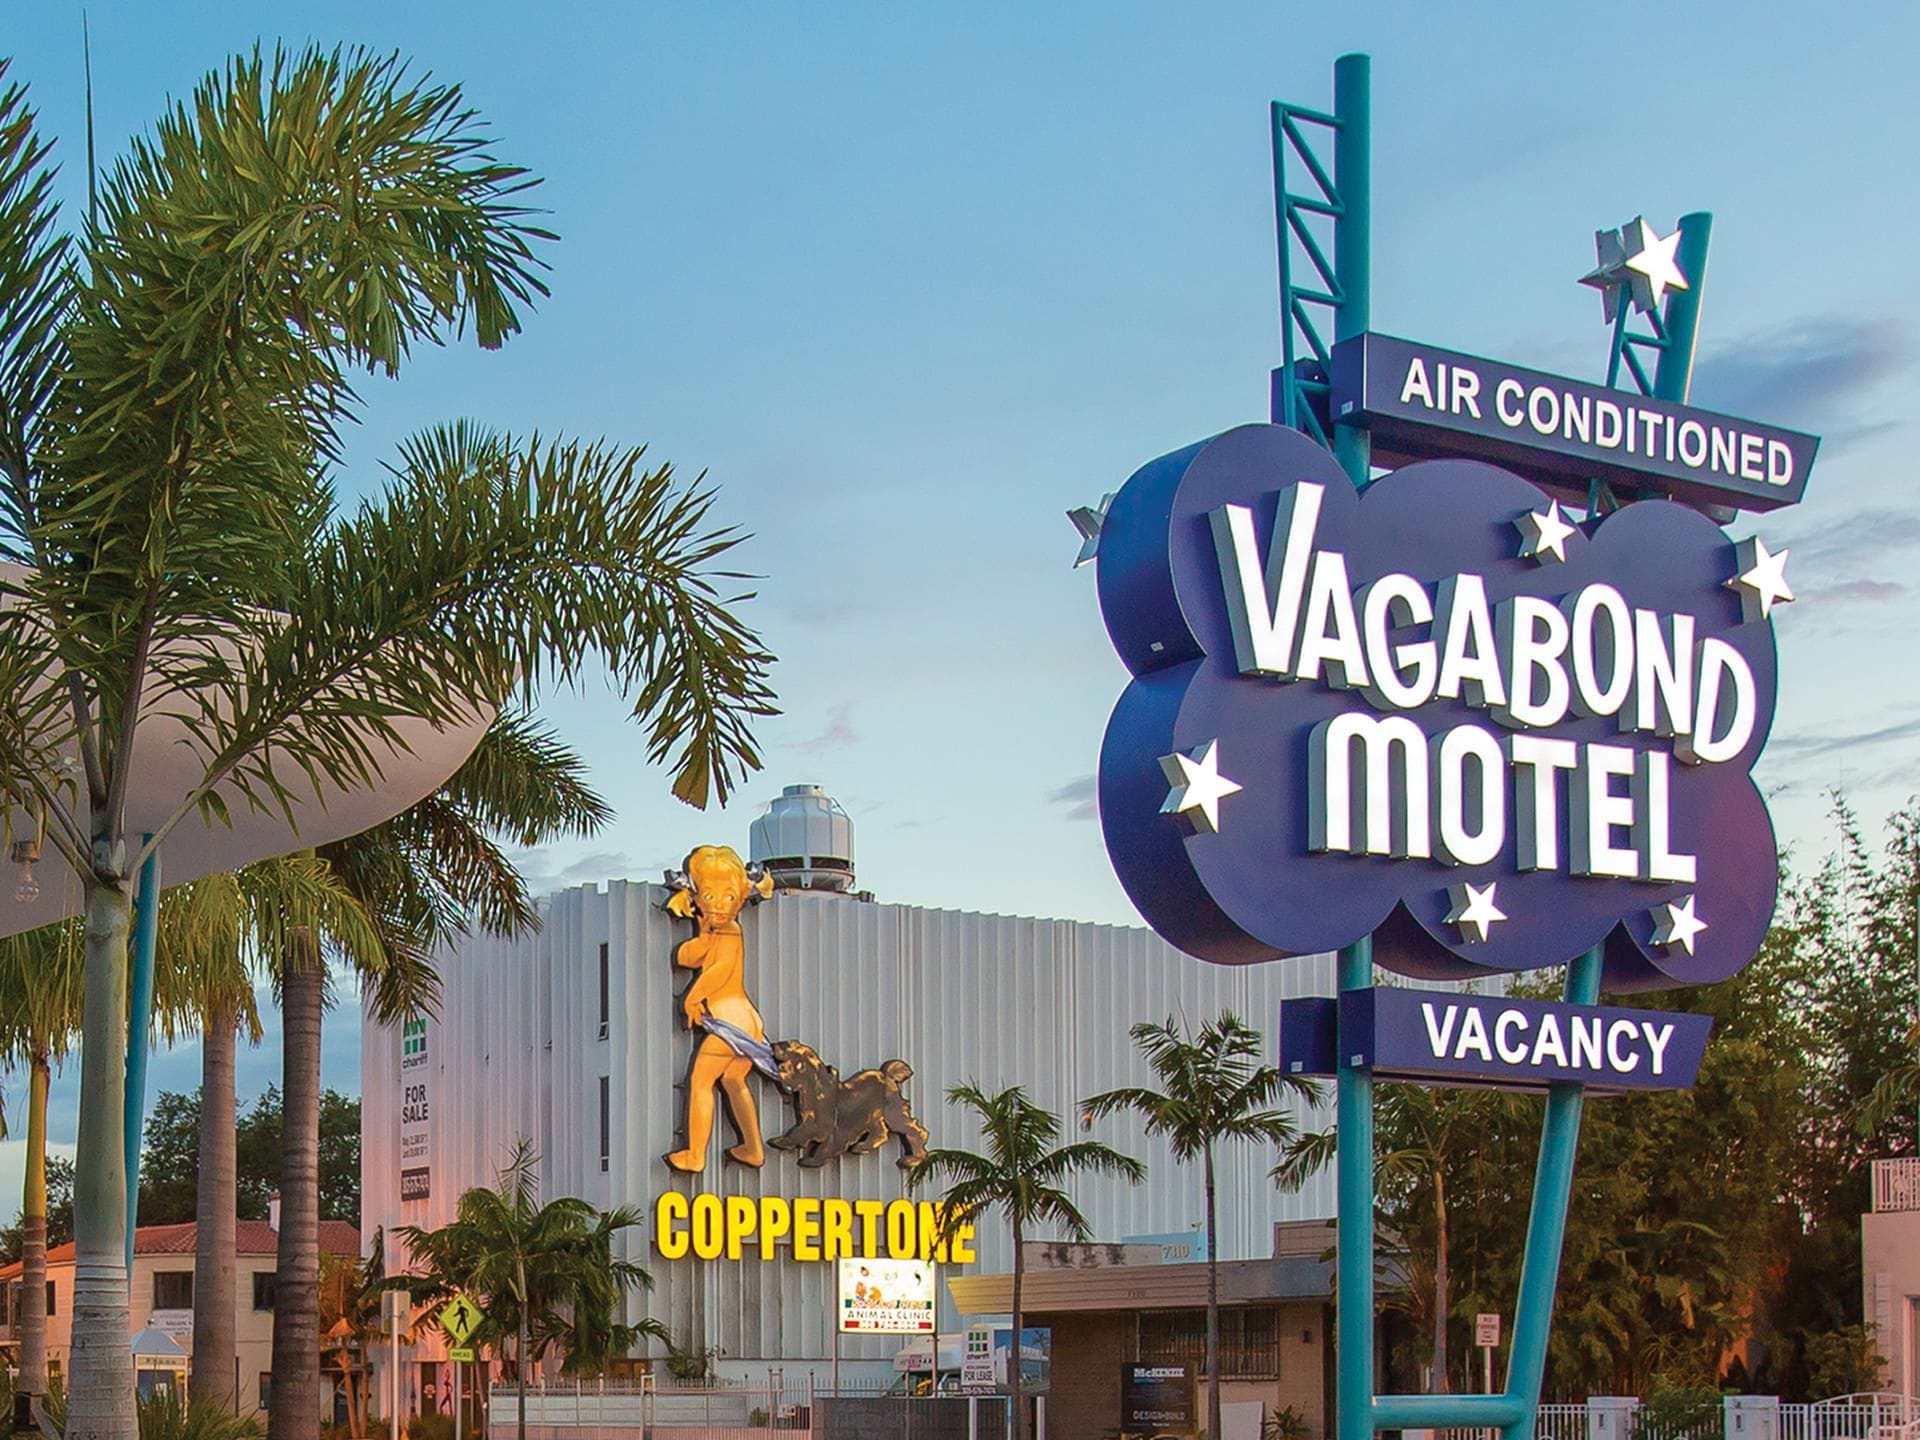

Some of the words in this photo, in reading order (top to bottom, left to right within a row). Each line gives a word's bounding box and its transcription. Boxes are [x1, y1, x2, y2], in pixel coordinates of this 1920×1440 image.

[1400, 356, 1482, 420] AIR
[1494, 377, 1795, 487] CONDITIONED
[1210, 480, 1757, 764] VAGABOND
[1310, 711, 1697, 884] MOTEL
[1420, 1002, 1676, 1076] VACANCY
[402, 1103, 429, 1124] SALE
[405, 1084, 427, 1105] FOR
[656, 1191, 977, 1264] COPPERTONE
[847, 1310, 893, 1320] ANIMAL
[896, 1311, 931, 1320] CLINIC
[964, 1370, 975, 1382] FOR
[976, 1370, 993, 1382] LEASE
